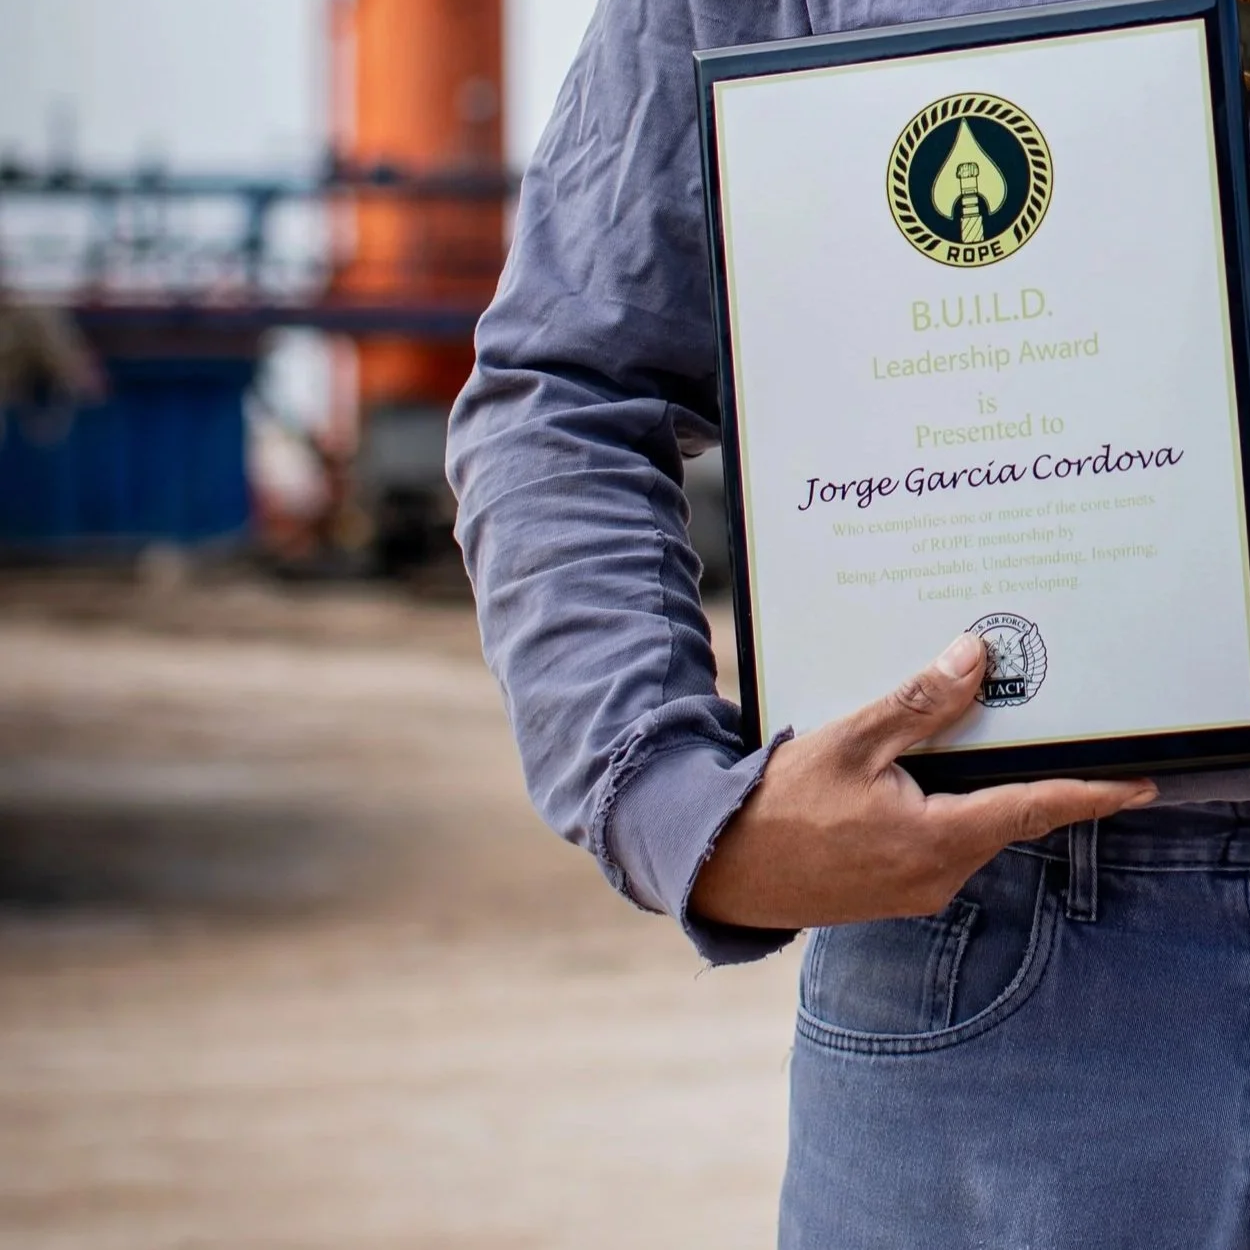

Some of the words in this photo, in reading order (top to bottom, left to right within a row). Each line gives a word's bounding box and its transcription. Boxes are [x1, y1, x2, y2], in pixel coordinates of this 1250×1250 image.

[946, 241, 1004, 262] ROPE
[911, 288, 1053, 332] B.U.I.L.D.
[872, 344, 1010, 380] Leadership
[1018, 332, 1099, 364] Award
[977, 391, 997, 414] is
[915, 413, 1033, 449] Presented
[1041, 414, 1064, 435] to
[798, 474, 900, 511] Jorge
[1031, 444, 1184, 480] Cordova
[832, 521, 865, 538] Who
[868, 512, 947, 535] exemplifies
[950, 513, 976, 526] one
[979, 509, 993, 524] or
[997, 506, 1032, 521] more
[1036, 500, 1052, 517] of
[1055, 498, 1076, 515] the
[1080, 496, 1111, 512] core
[1114, 494, 1156, 510] tenets
[911, 536, 928, 554] of
[930, 534, 973, 552] ROPE
[977, 527, 1055, 549] mentorship
[1058, 524, 1075, 541] by
[836, 568, 877, 587] Being
[981, 579, 992, 596] &
[986, 617, 1000, 627] AIR
[1002, 616, 1028, 631] FORCE
